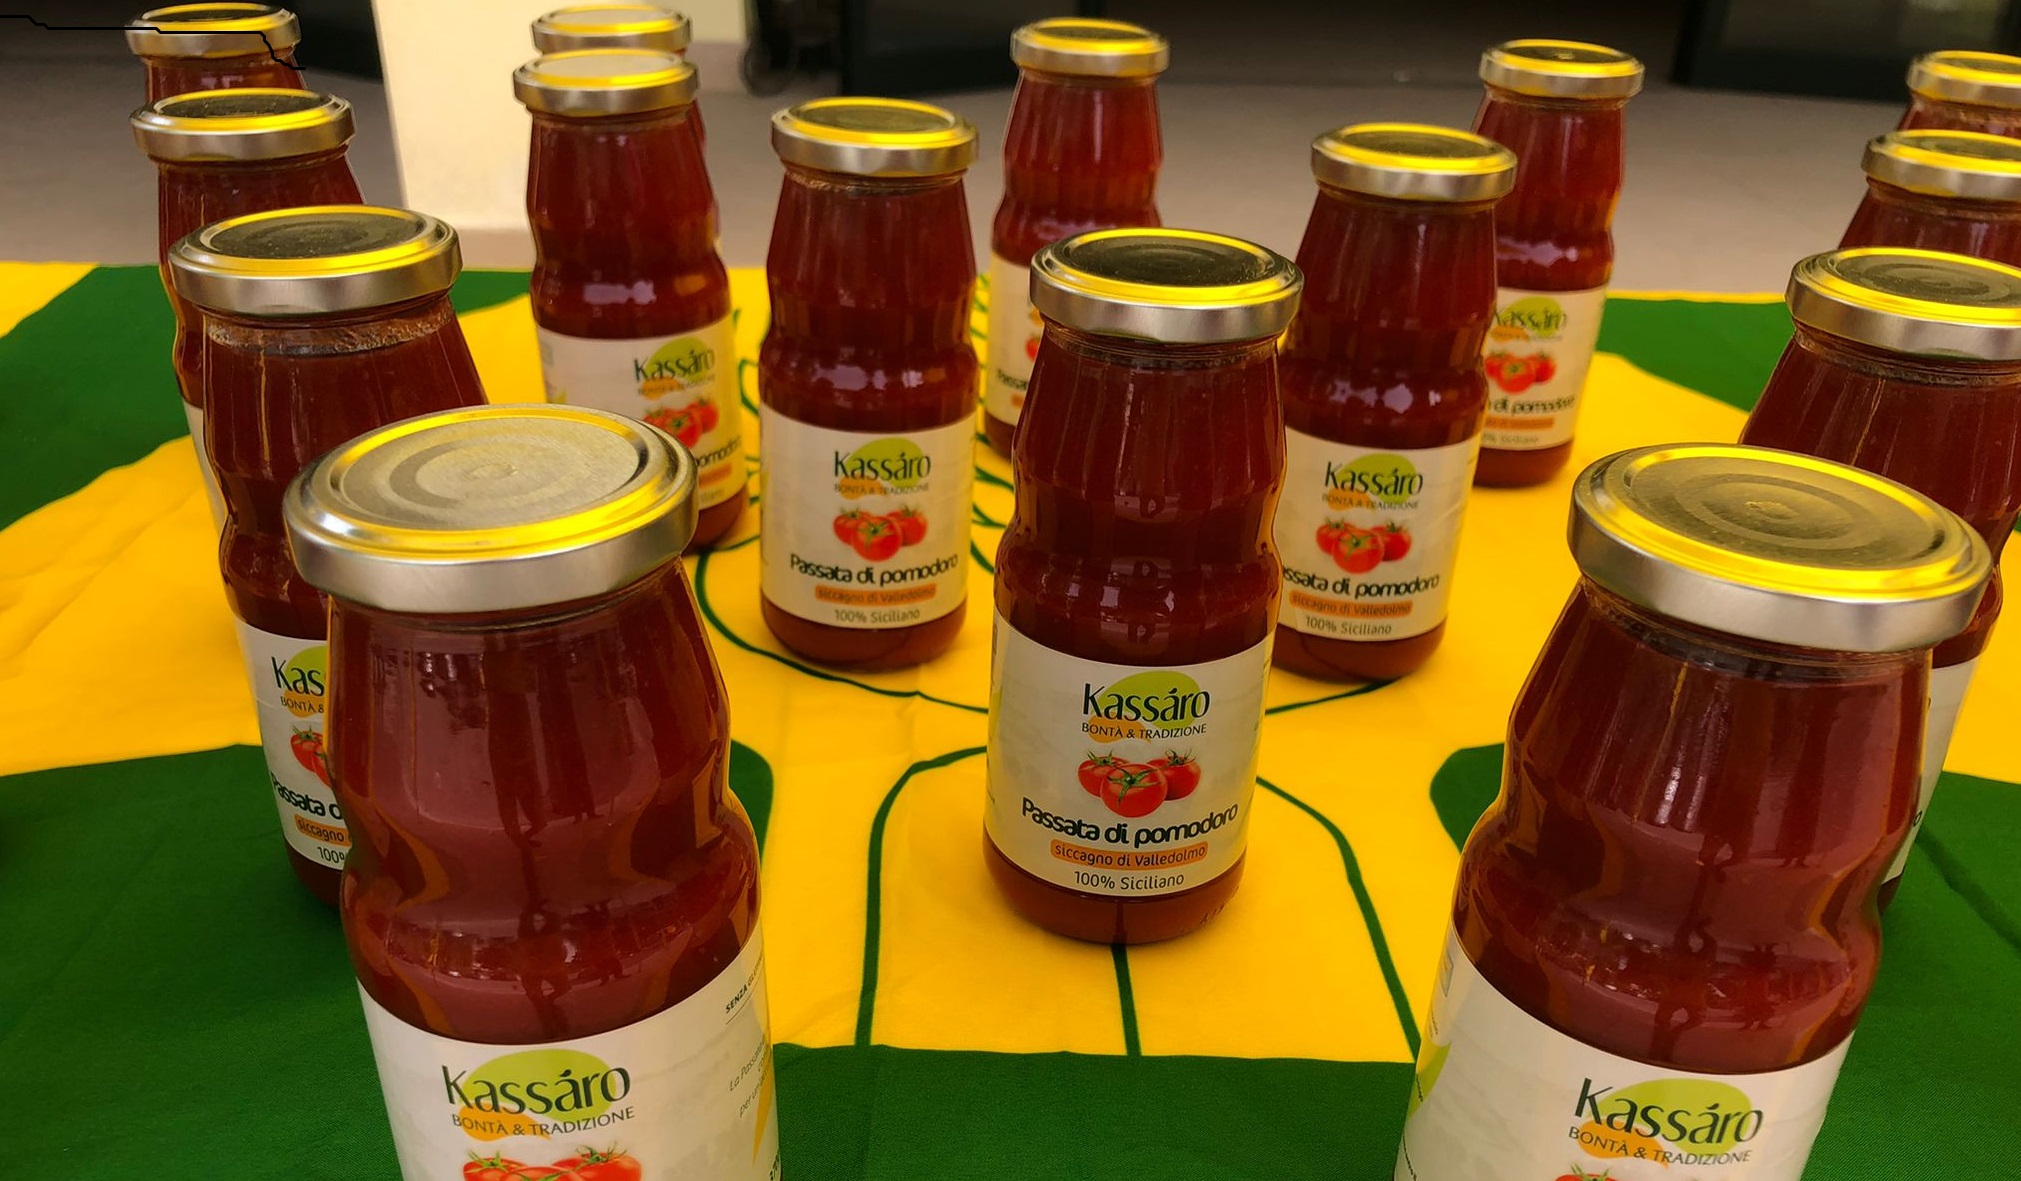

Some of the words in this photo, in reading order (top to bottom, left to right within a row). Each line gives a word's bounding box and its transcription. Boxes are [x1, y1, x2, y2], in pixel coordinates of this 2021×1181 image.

[833, 451, 931, 481] Kassáro
[1324, 461, 1424, 497] Kassáro
[790, 553, 852, 584] Passata
[856, 566, 876, 585] di
[879, 554, 959, 588] pomodoro
[869, 592, 880, 604] di
[1332, 576, 1351, 598] di
[1354, 574, 1440, 601] pomodoro
[834, 608, 868, 624] 100%
[870, 608, 921, 624] Siciliano
[1339, 600, 1351, 614] di
[1354, 601, 1412, 617] Valledolmo
[1305, 615, 1337, 633] 100%
[1341, 621, 1393, 637] Siciliano
[1082, 682, 1211, 723] Kassáro
[1081, 721, 1124, 739] BONTÀ
[1126, 728, 1137, 740] &
[1138, 723, 1208, 740] TRADIZIONE
[298, 818, 345, 842] siccagno
[1021, 796, 1101, 842] Passata
[1104, 822, 1130, 845] di
[1134, 803, 1239, 849] pomodoro
[1054, 843, 1114, 868] siccagno
[1117, 852, 1131, 868] di
[1135, 845, 1207, 868] Valledolmo
[1074, 870, 1116, 891] 100%
[1120, 873, 1185, 892] Siciliano
[726, 984, 748, 1014] SENZA
[441, 1064, 632, 1115] Kassáro
[451, 1112, 509, 1136] BONTÀ
[512, 1124, 526, 1136] &
[528, 1106, 636, 1136] TRADIZIONE
[1574, 1077, 1765, 1145] Kassáro
[1568, 1125, 1629, 1158] BONTÀ
[1633, 1146, 1647, 1159] &
[1653, 1149, 1753, 1167] TRADIZIONE
